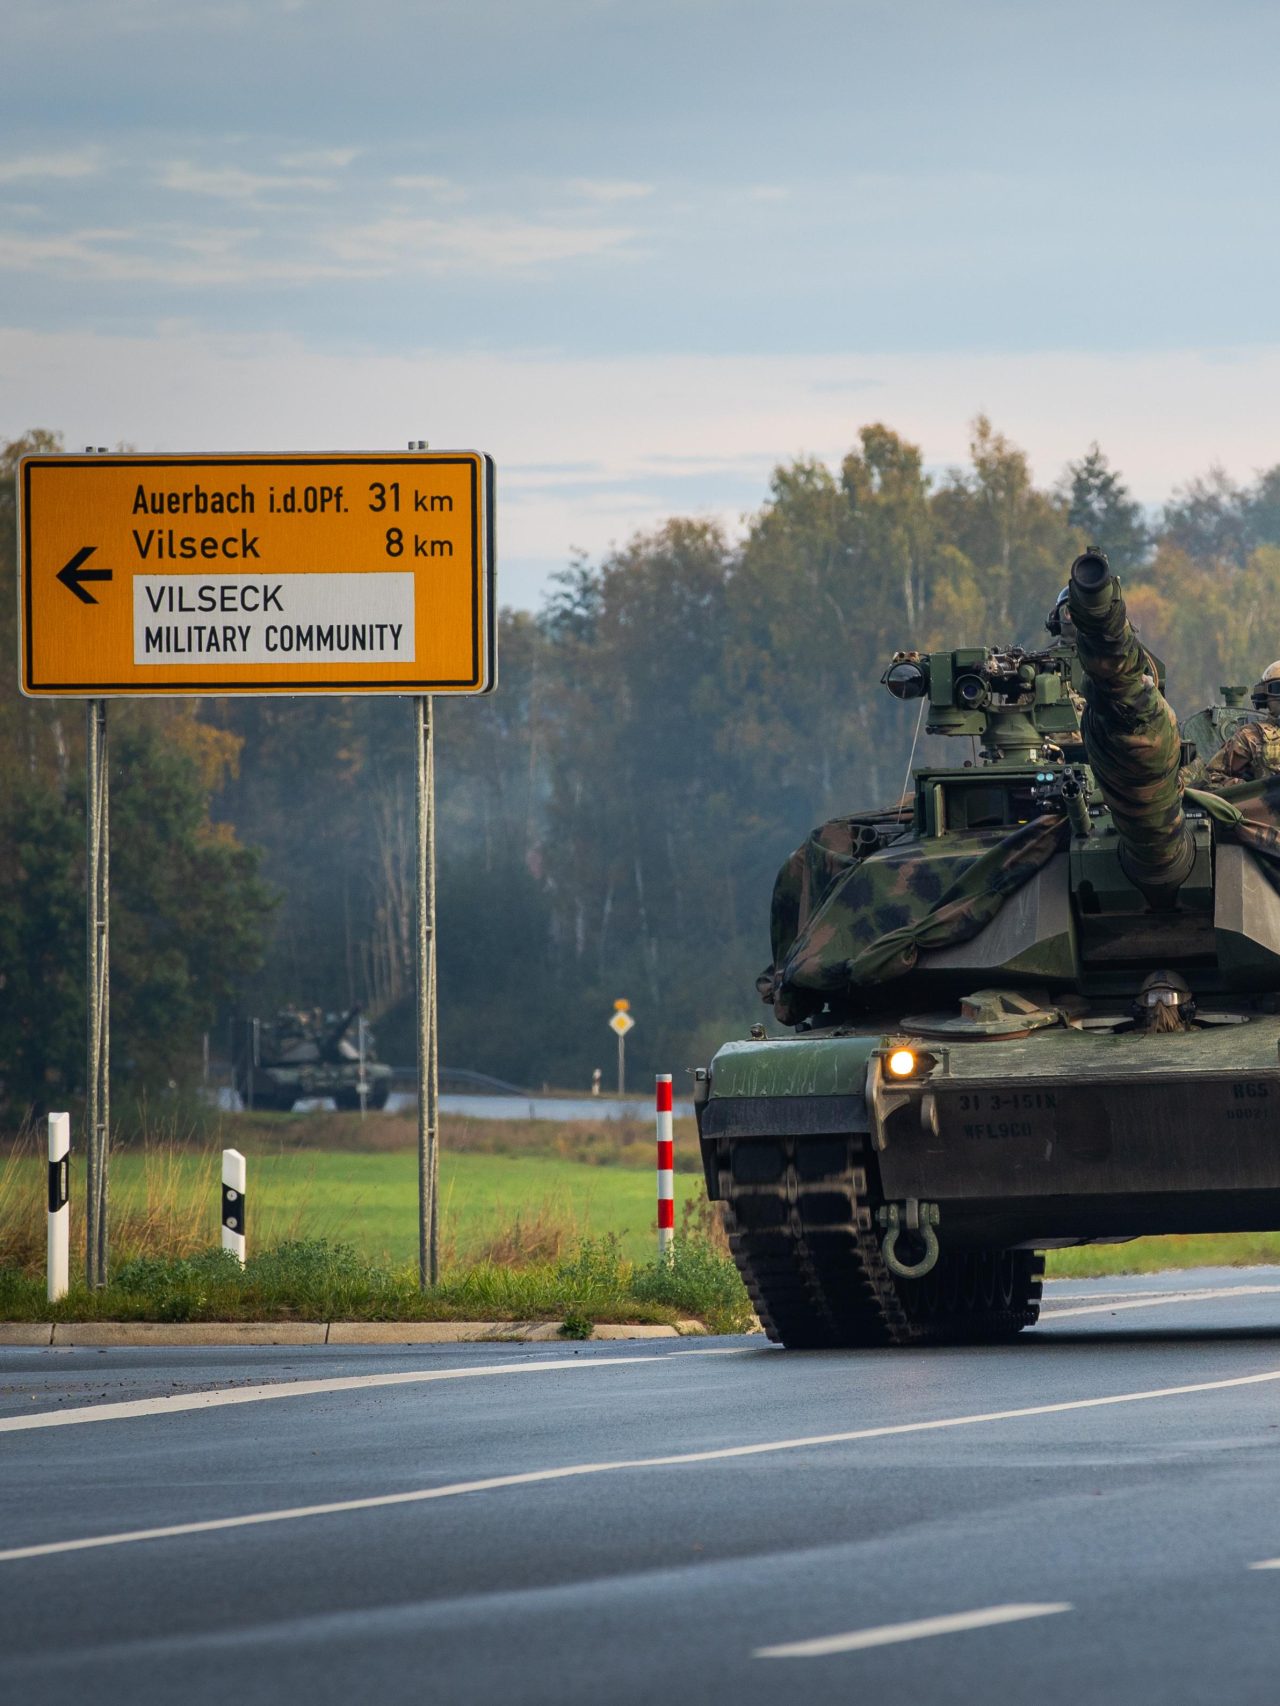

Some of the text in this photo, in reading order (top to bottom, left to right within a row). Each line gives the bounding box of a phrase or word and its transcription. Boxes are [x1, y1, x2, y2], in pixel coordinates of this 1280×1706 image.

[131, 481, 453, 515] Auerbach i.d.OPf. 31 km
[132, 527, 454, 560] Vilseck 8 km
[144, 584, 284, 613] VILSECK
[145, 623, 403, 654] MILITARY COMMUNITY
